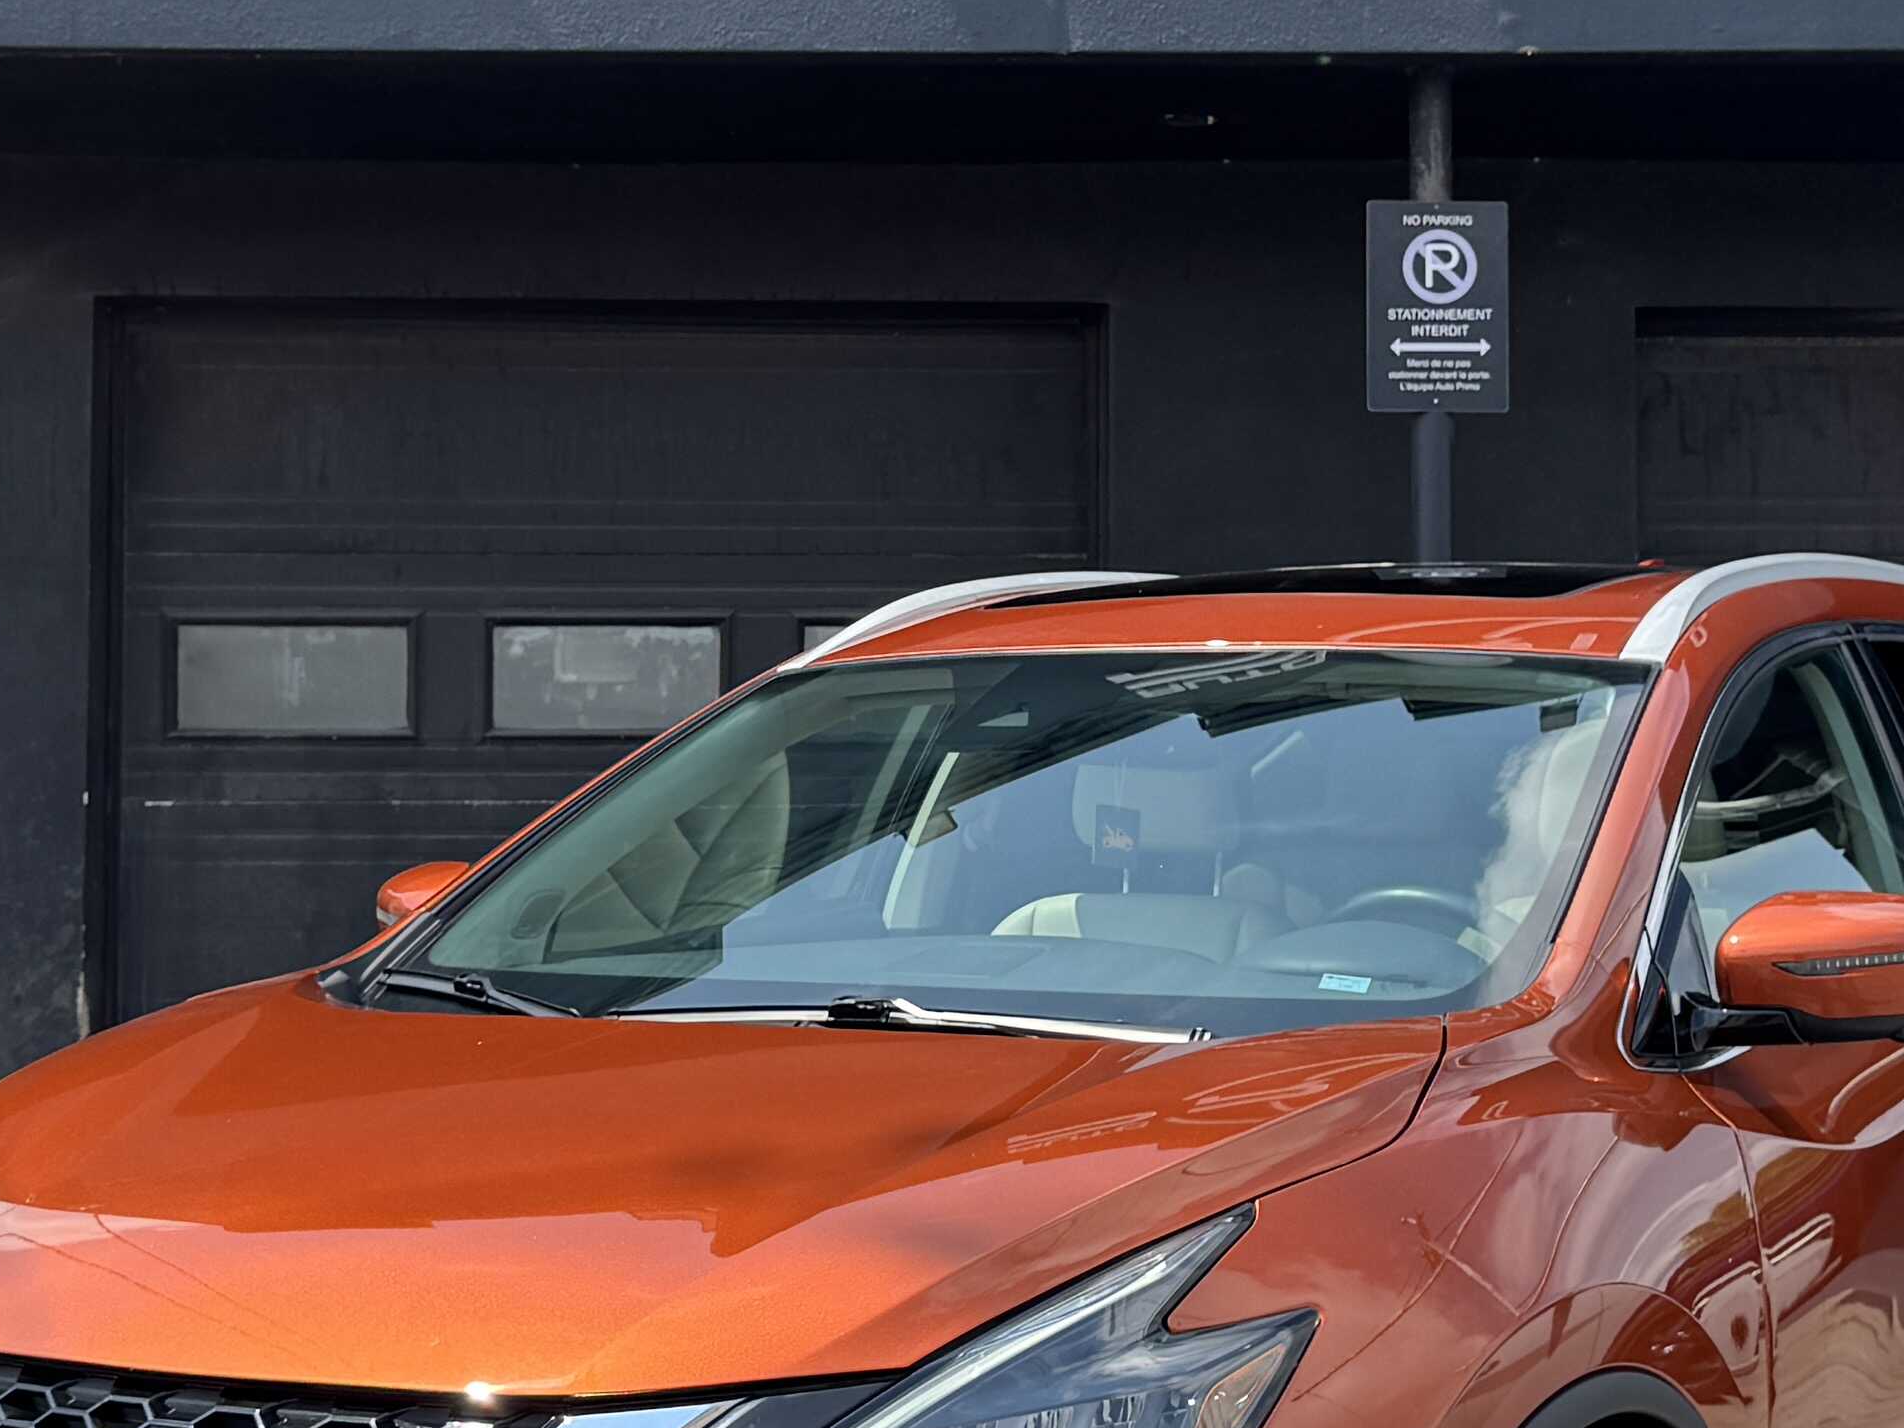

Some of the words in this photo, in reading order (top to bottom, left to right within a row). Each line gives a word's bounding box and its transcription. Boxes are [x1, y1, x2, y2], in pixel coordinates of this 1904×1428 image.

[1402, 214, 1422, 226] NO
[1423, 214, 1473, 226] PARKING
[1387, 308, 1493, 321] STATIONNEMENT
[1411, 324, 1470, 337] INTERDIT
